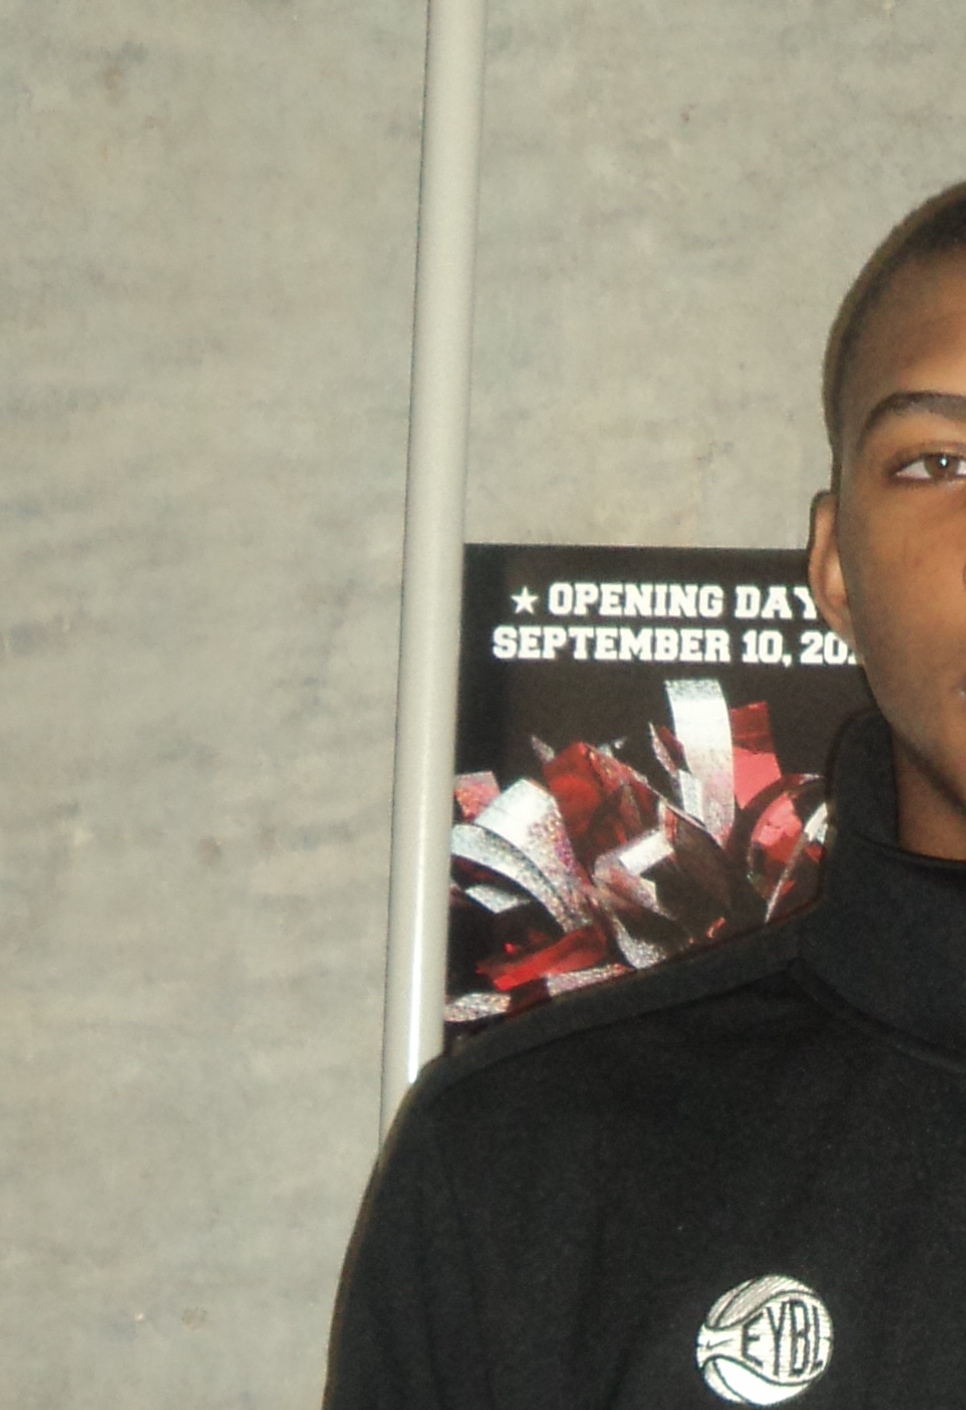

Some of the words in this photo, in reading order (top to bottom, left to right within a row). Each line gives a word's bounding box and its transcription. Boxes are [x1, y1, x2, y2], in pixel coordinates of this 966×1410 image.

[548, 581, 725, 619] OPENING
[733, 584, 819, 620] DAY
[491, 624, 732, 663] SEPTEMBER
[742, 629, 793, 668] 10,
[799, 629, 858, 666] 20
